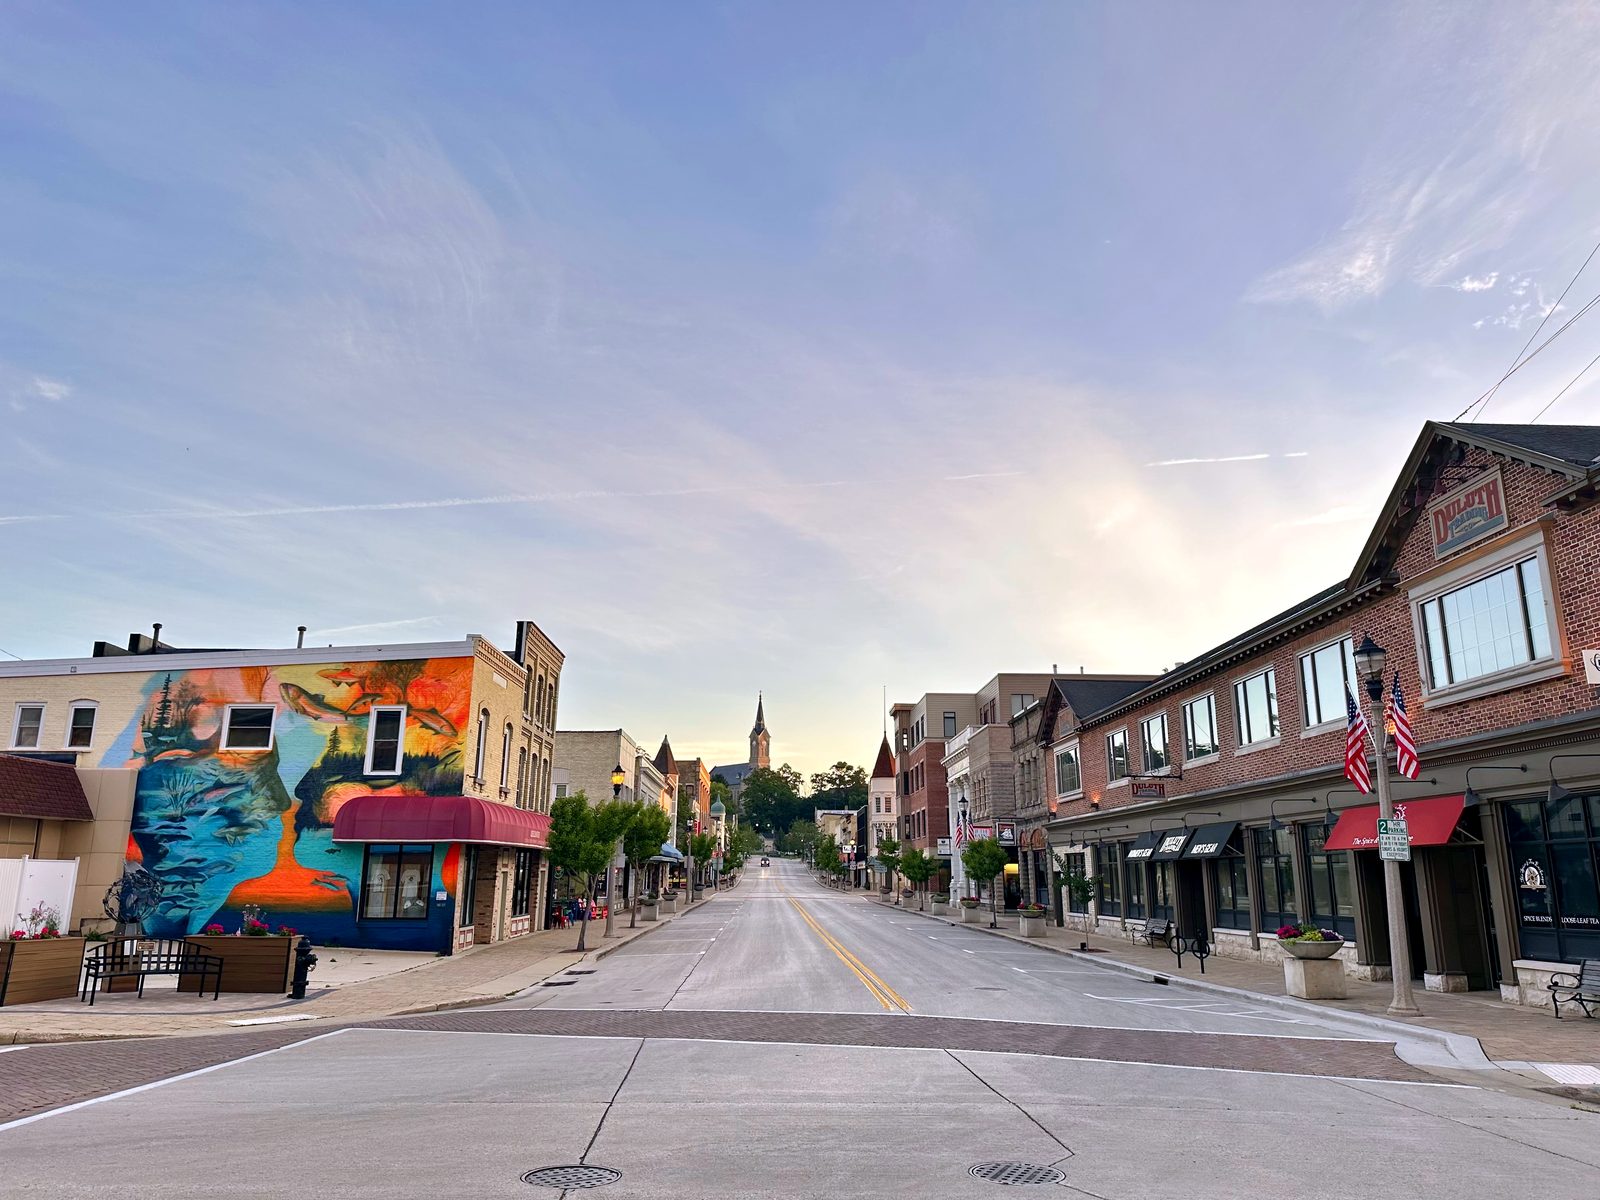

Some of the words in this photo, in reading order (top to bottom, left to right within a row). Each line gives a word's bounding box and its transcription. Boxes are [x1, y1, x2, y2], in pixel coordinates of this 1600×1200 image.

[1433, 478, 1502, 545] DULUTH
[1132, 783, 1165, 795] DULUTH
[1380, 821, 1387, 833] 2
[1352, 837, 1361, 845] The
[1536, 915, 1552, 923] BLENDS
[1589, 917, 1600, 925] TEA
